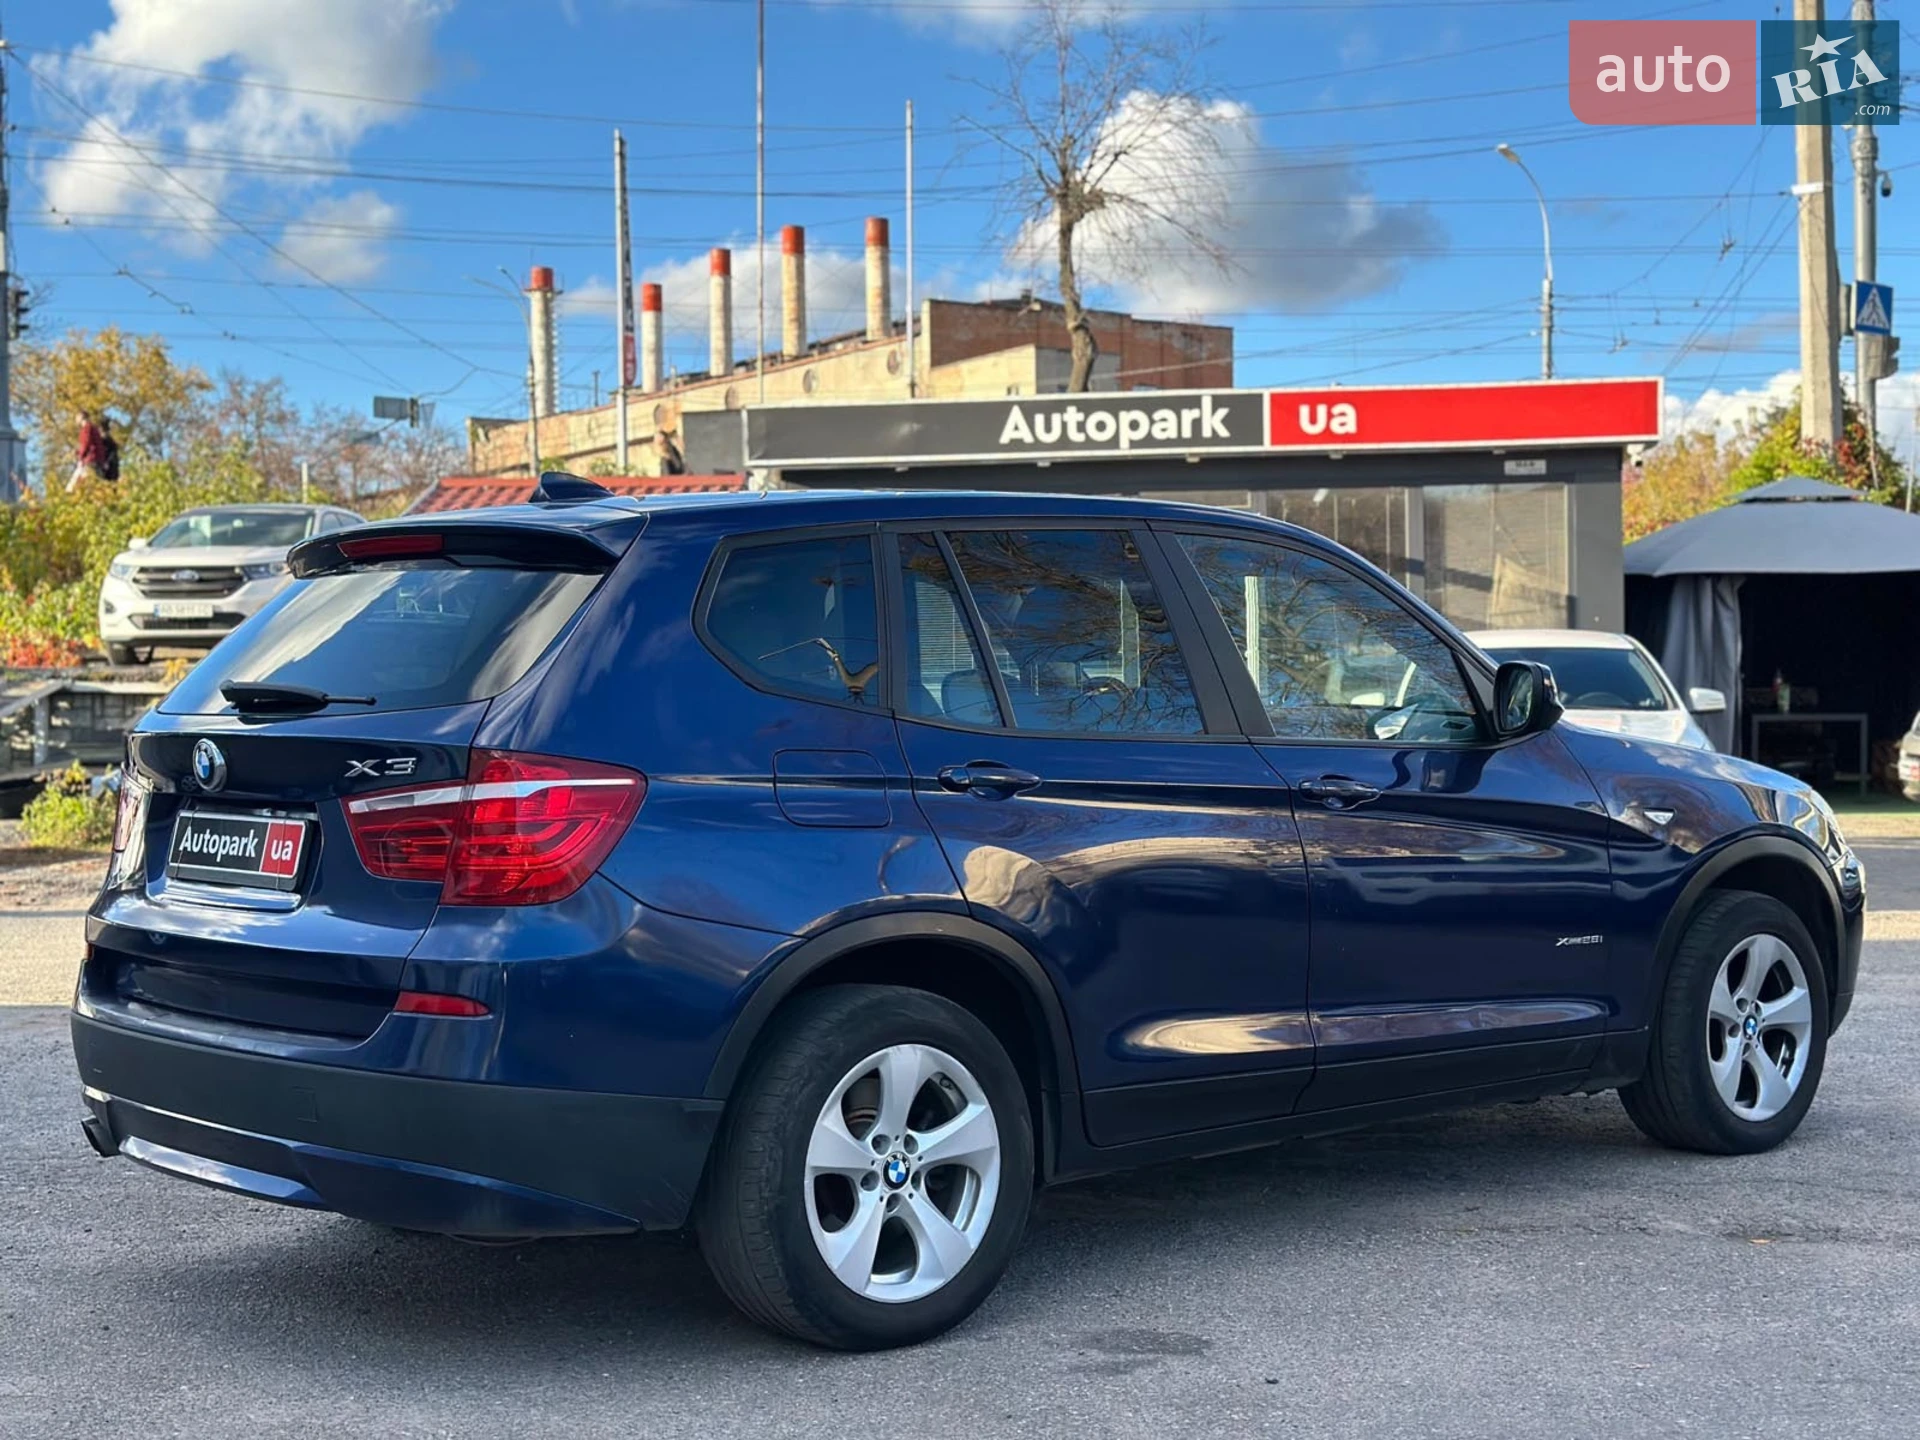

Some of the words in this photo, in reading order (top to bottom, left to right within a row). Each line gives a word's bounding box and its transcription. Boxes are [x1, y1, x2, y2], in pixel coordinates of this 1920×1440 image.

[999, 395, 1231, 448] Autopark
[1298, 402, 1358, 435] ua
[344, 757, 417, 778] X3
[179, 826, 258, 863] Autopark
[271, 839, 293, 861] ua
